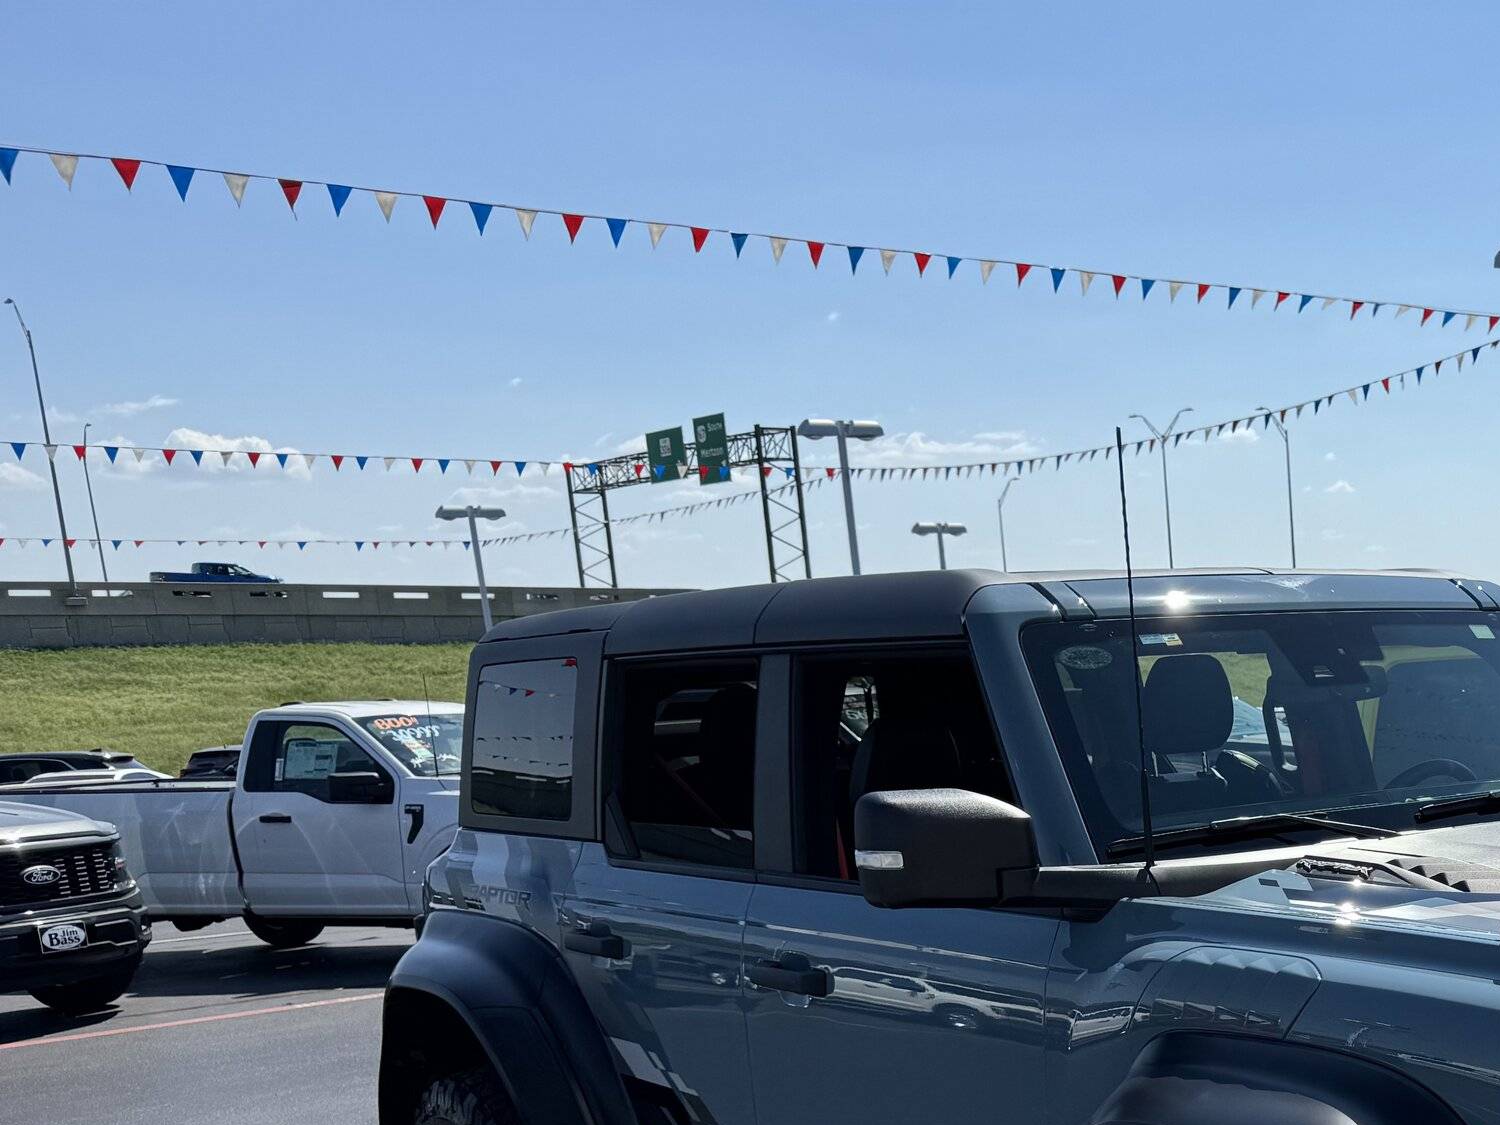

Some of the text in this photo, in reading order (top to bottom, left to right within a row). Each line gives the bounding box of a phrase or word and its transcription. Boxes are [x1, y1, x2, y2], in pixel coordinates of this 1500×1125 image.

[31, 870, 54, 882] Ford
[48, 932, 81, 947] Bass
[61, 929, 78, 938] Jim
